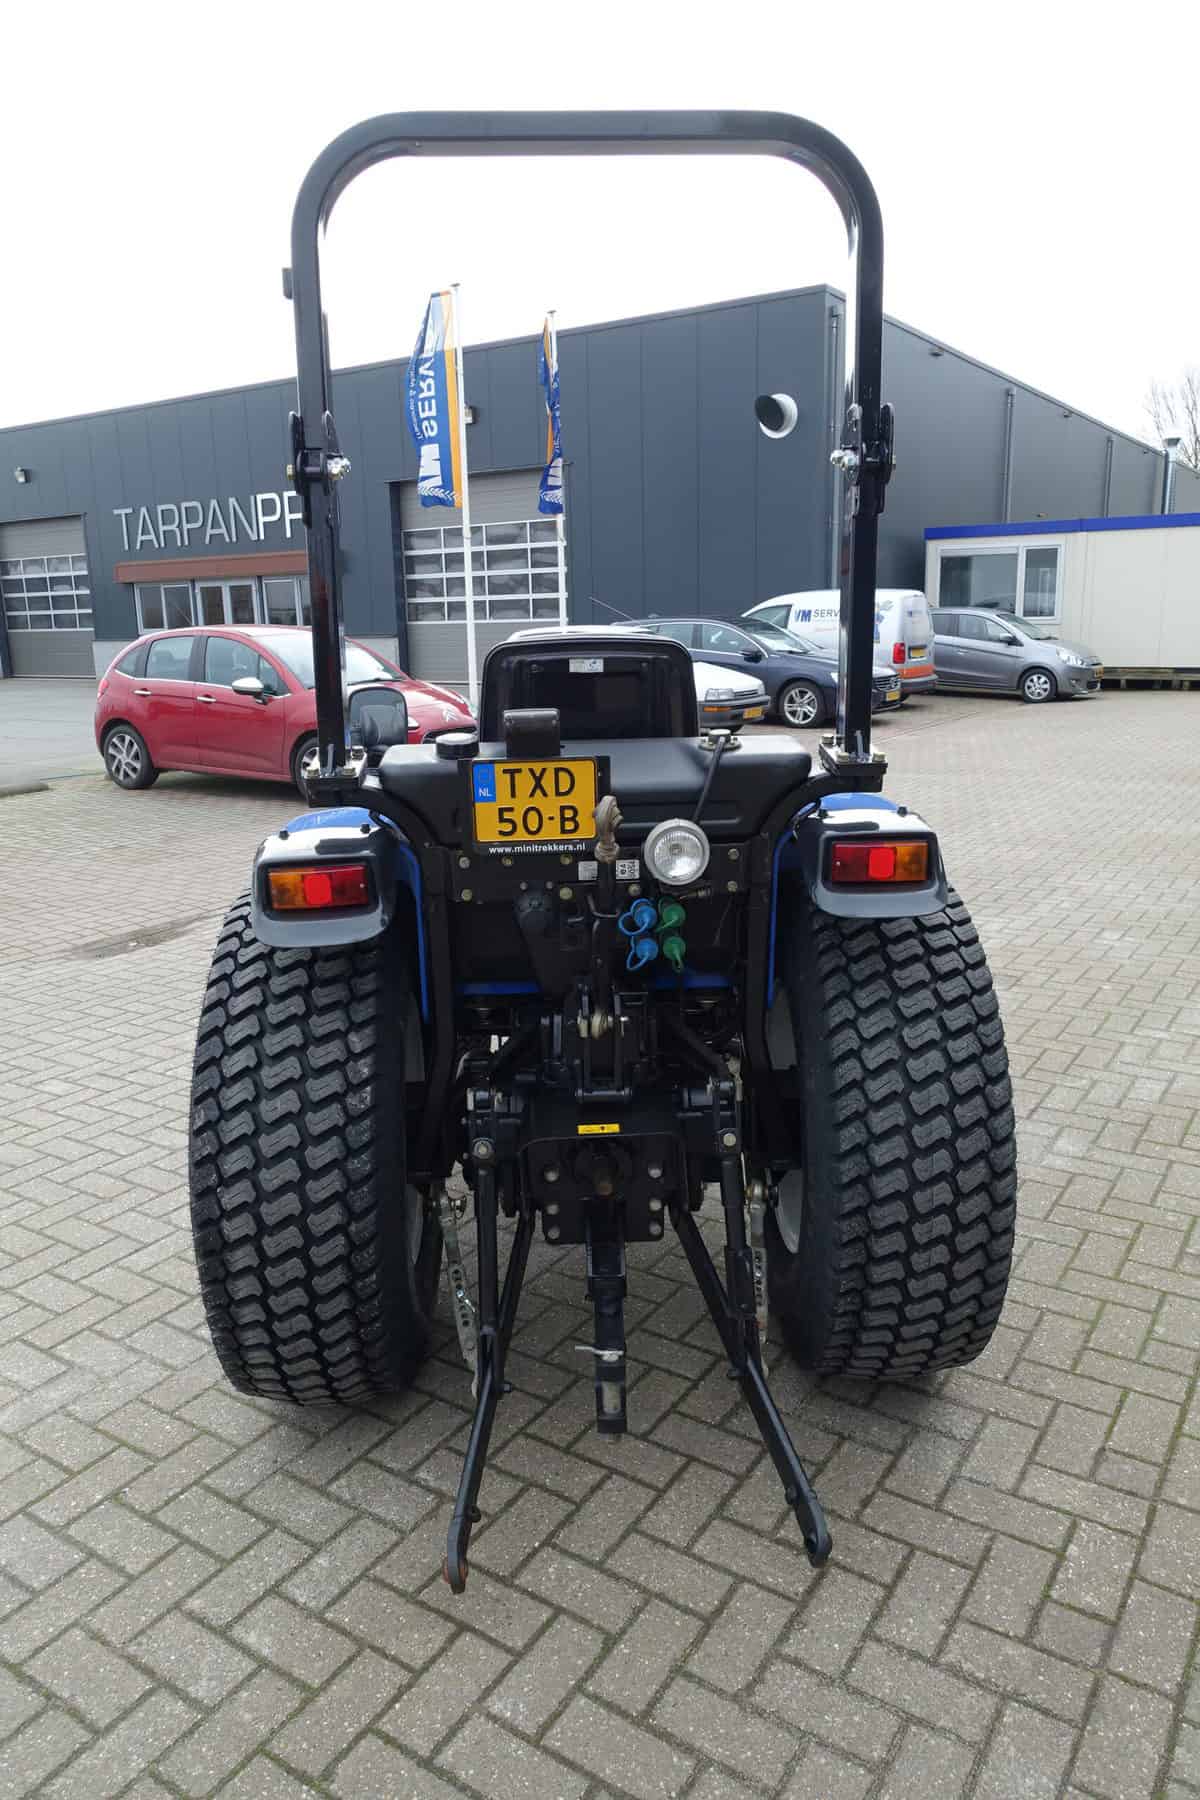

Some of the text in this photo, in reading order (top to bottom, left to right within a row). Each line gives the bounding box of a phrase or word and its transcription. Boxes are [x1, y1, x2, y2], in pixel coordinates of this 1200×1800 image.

[794, 609, 812, 622] VM
[502, 766, 576, 799] TXD
[479, 787, 492, 797] NL
[497, 804, 580, 837] 50-B
[488, 842, 586, 855] www.minitrekkers.nl
